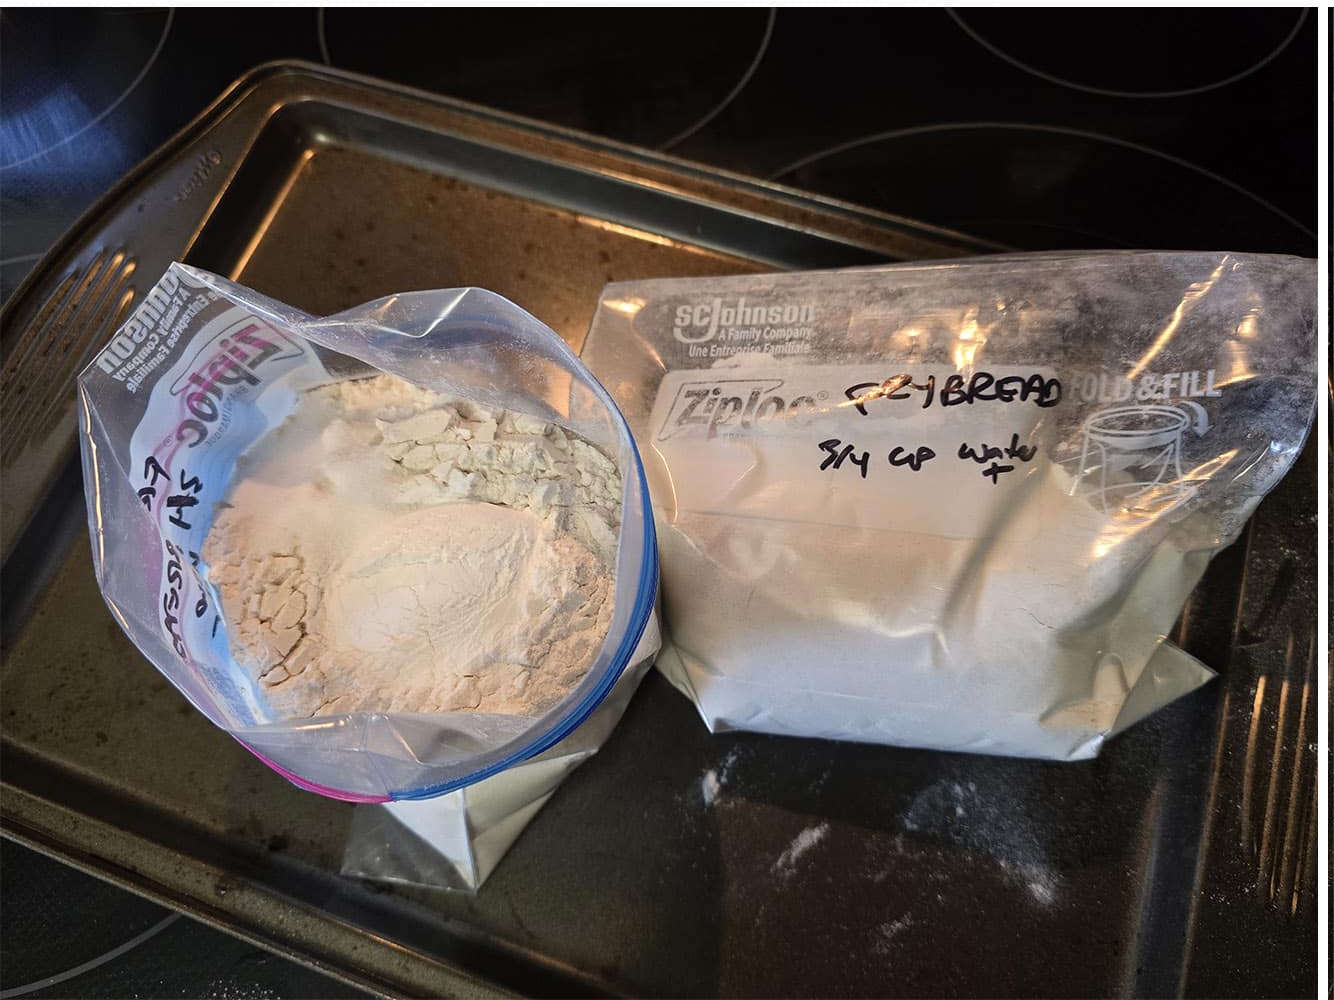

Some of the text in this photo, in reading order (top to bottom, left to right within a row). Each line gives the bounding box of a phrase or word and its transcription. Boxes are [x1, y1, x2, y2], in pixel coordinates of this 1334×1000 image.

[718, 326, 812, 343] A Family Company
[689, 343, 708, 357] Une
